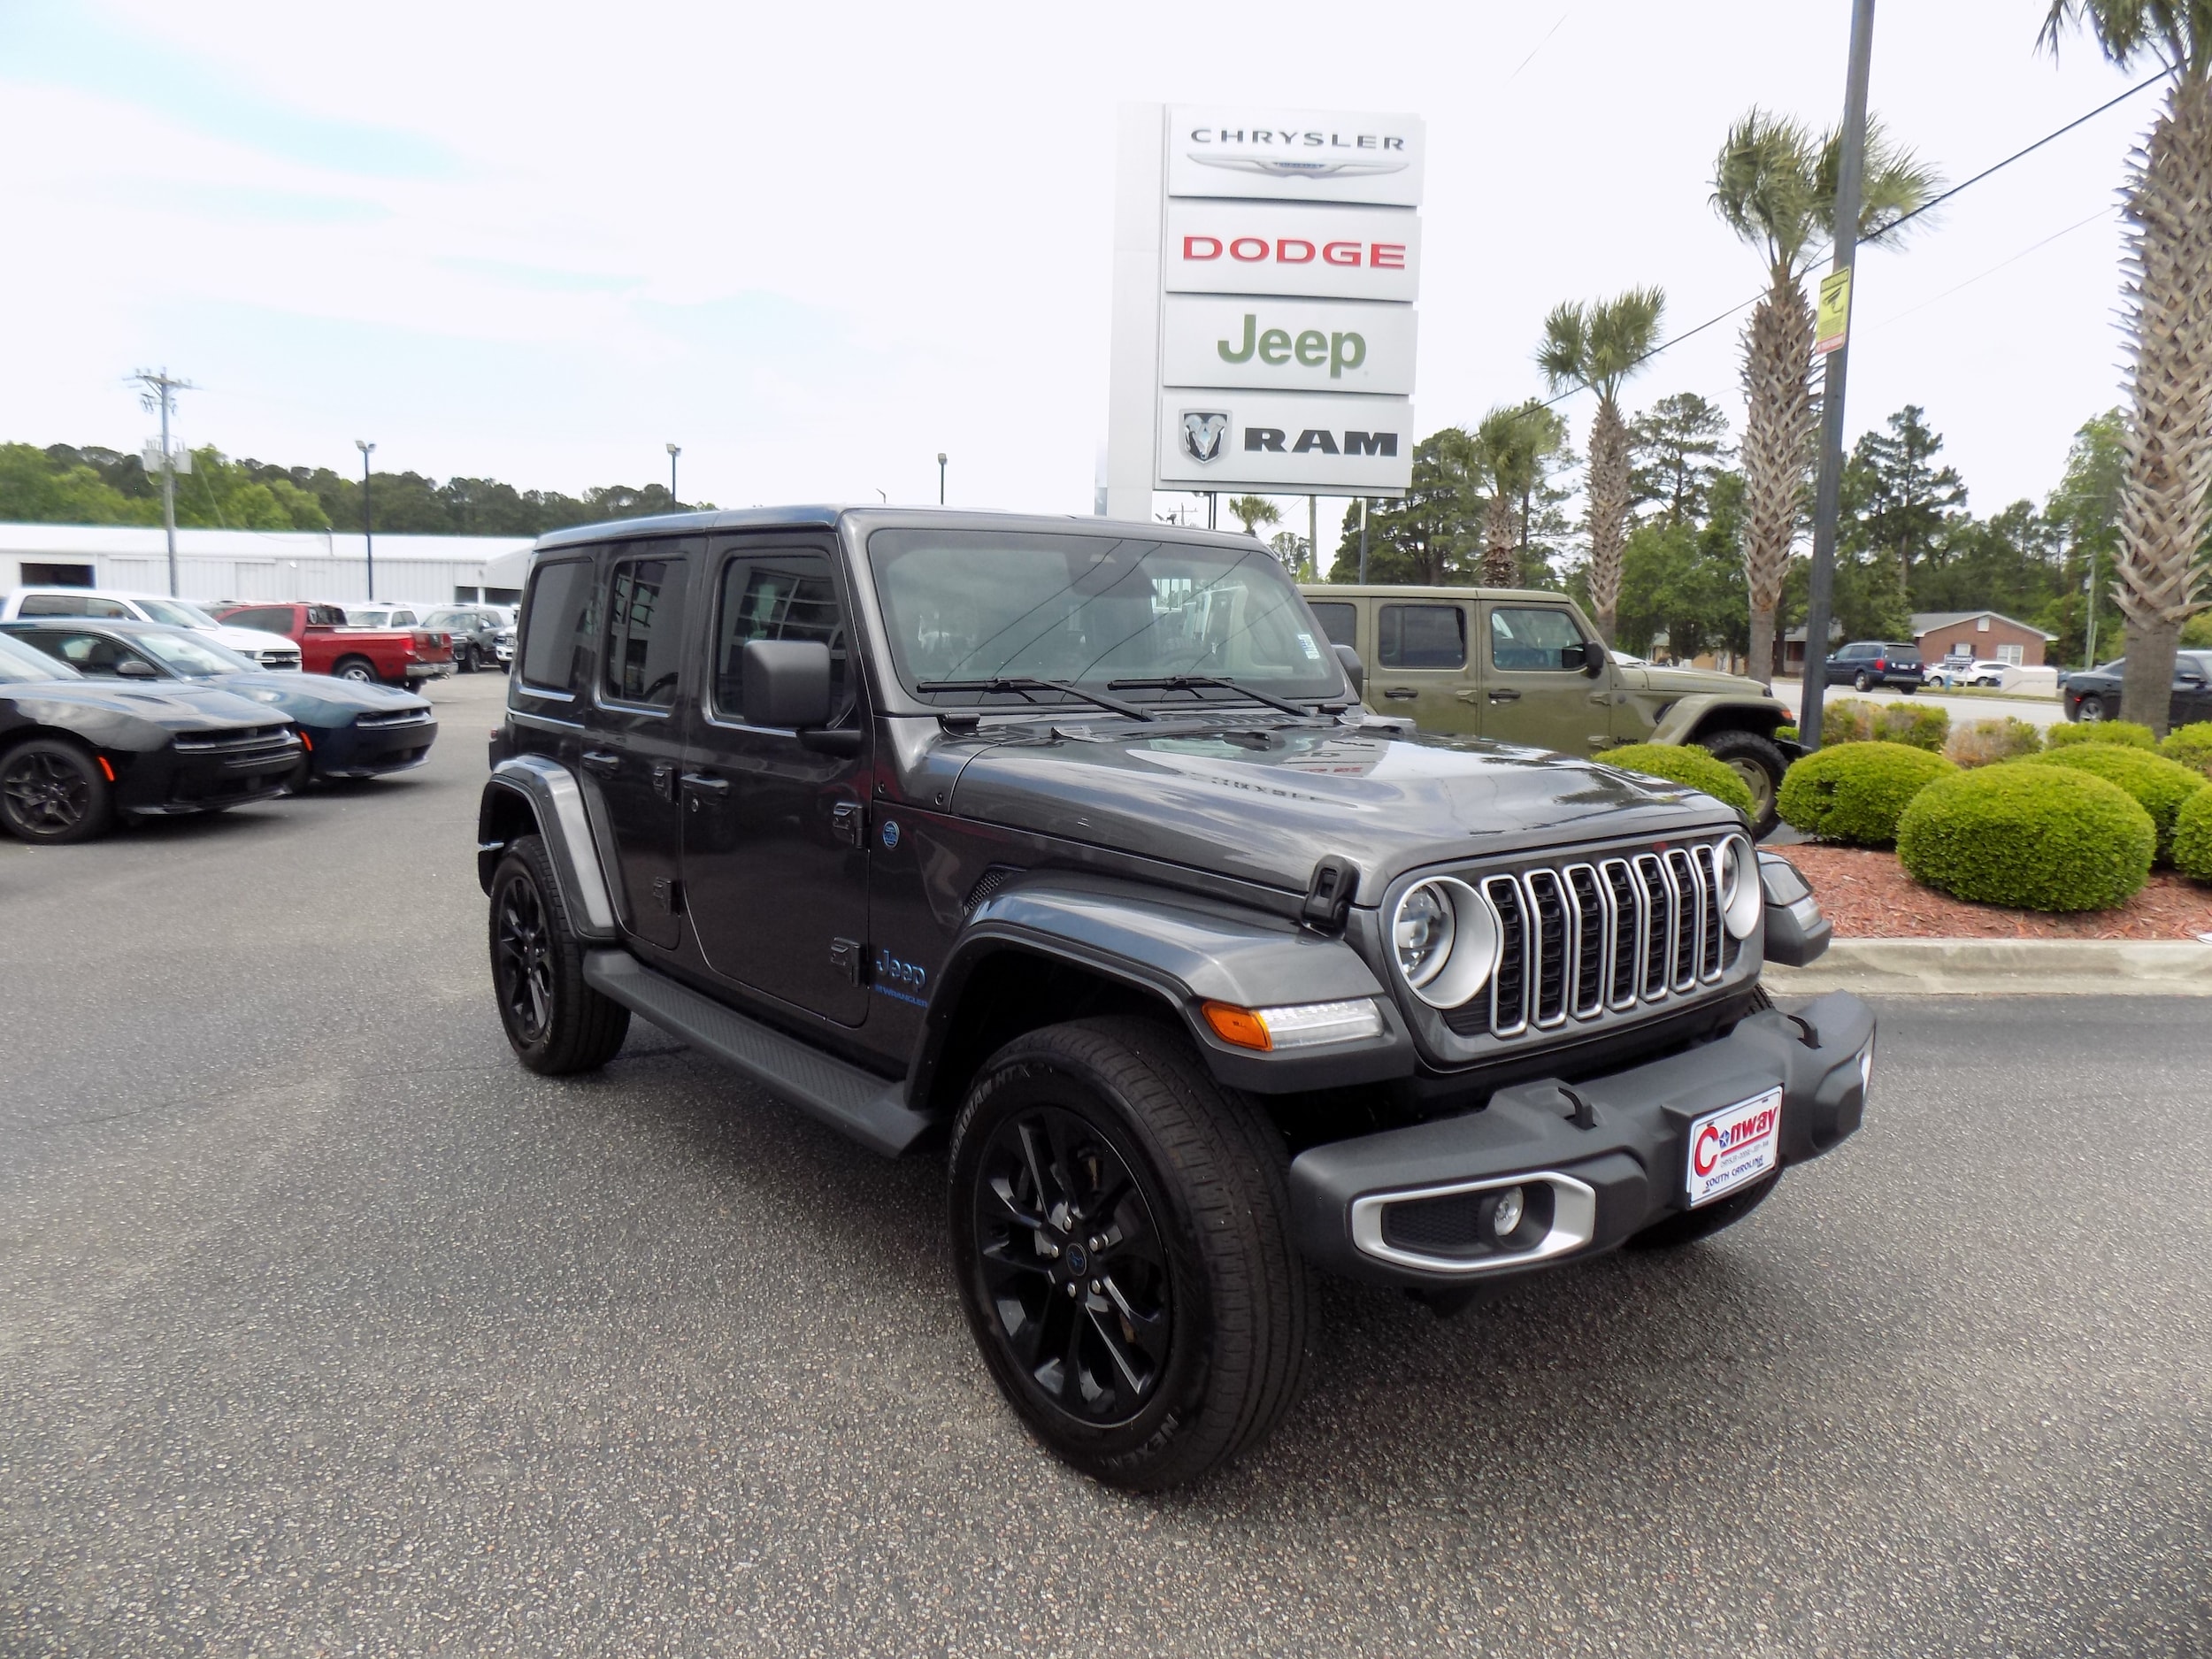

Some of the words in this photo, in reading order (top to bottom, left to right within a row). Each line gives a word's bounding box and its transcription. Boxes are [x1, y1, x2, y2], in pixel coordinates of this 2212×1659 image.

[1190, 128, 1405, 151] CHRYSLER
[1182, 235, 1407, 270] DODGE
[1217, 313, 1367, 380] Jeep
[1244, 426, 1399, 457] RAM
[876, 949, 926, 993] Jeep
[1705, 1171, 1730, 1189] SOUTH
[1731, 1154, 1764, 1177] CAROLINA
